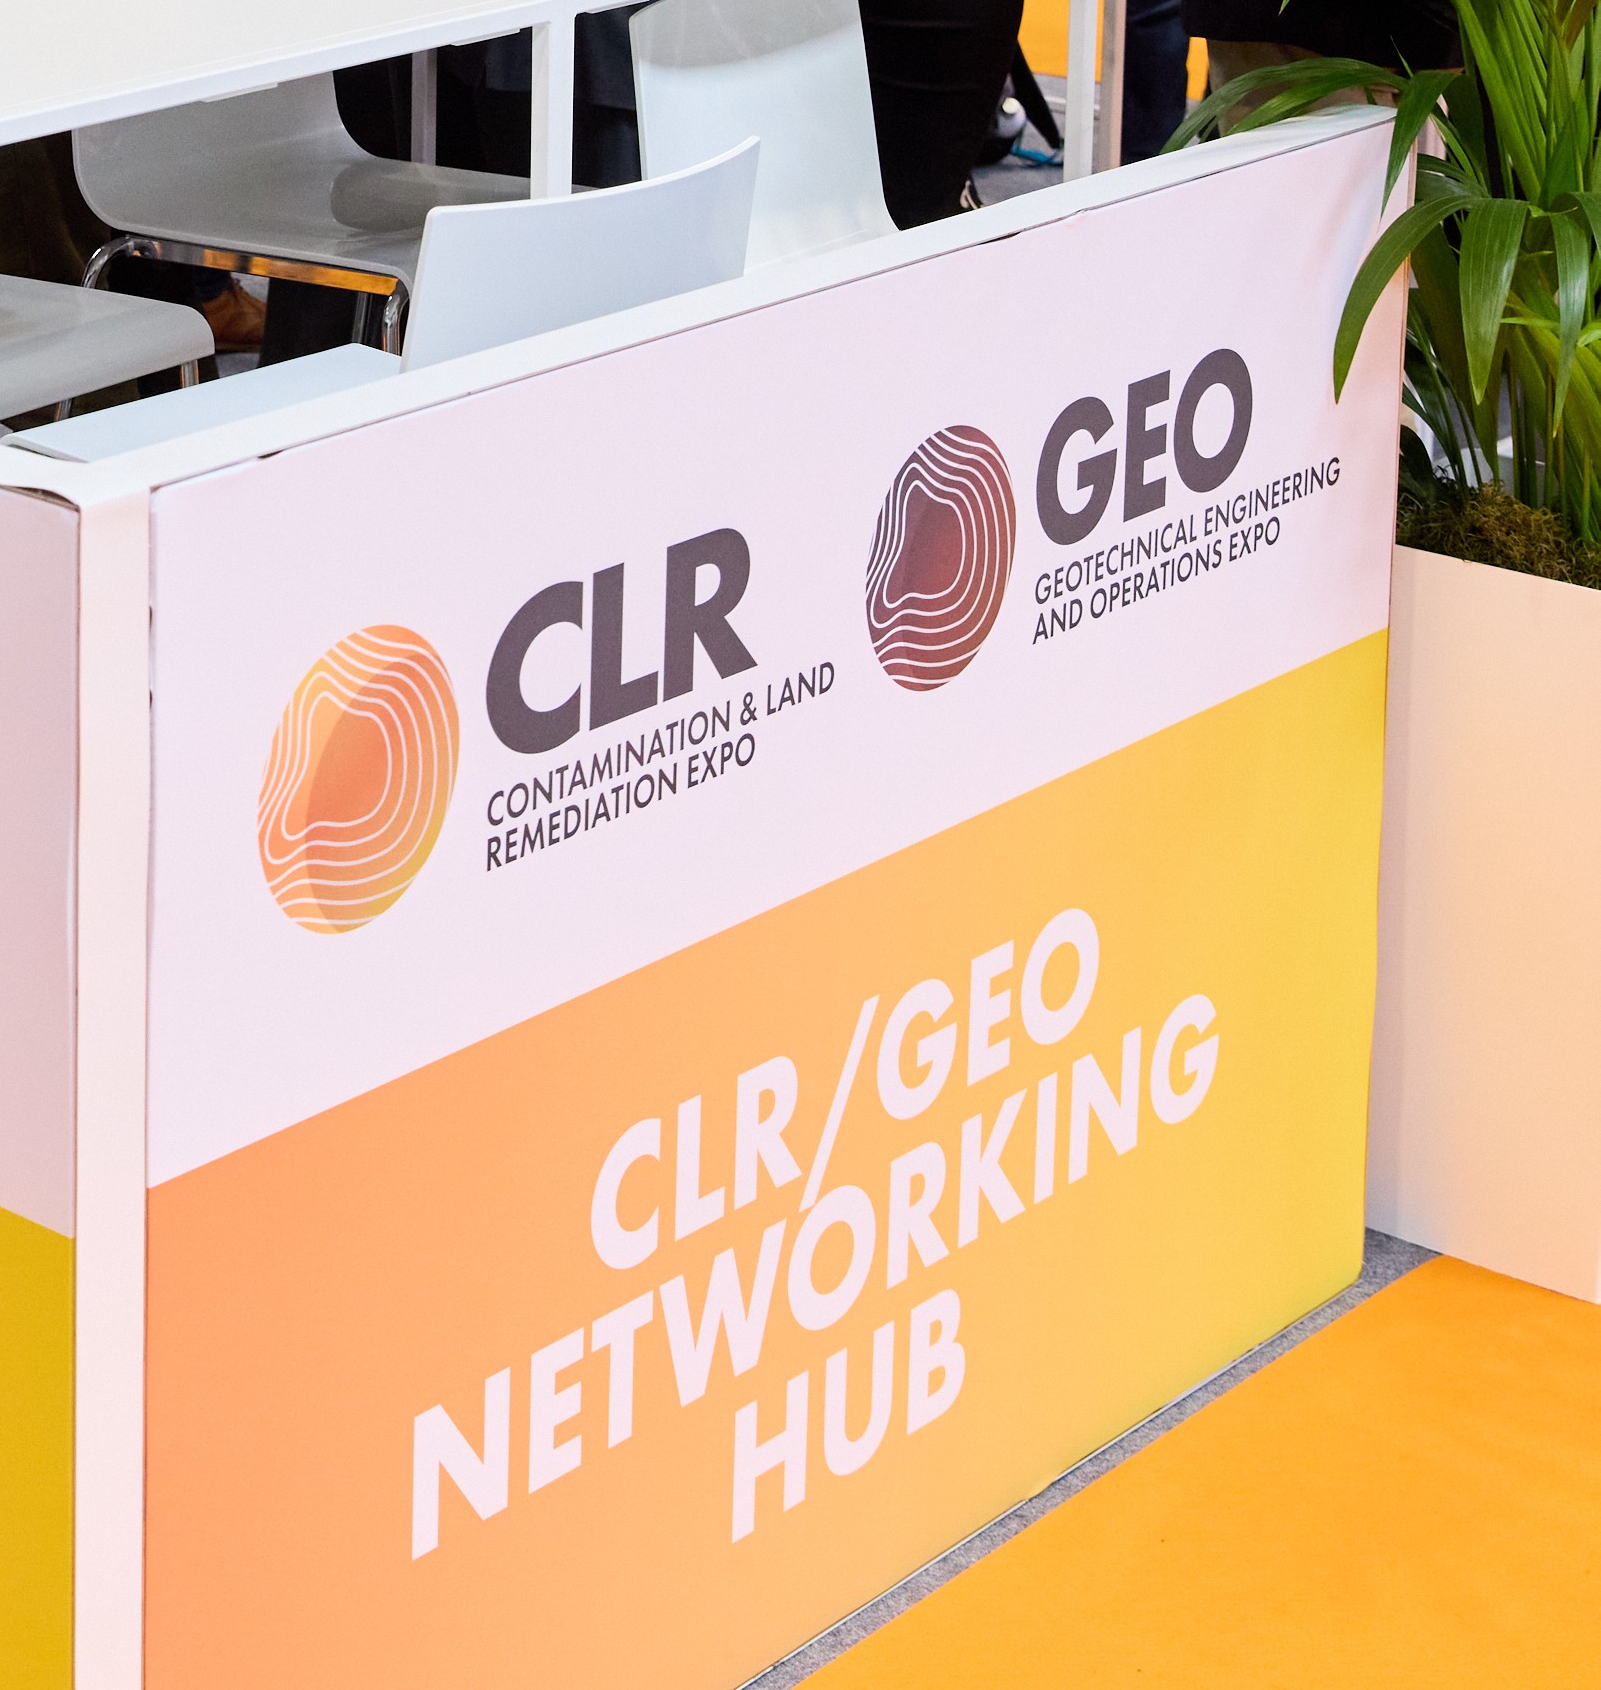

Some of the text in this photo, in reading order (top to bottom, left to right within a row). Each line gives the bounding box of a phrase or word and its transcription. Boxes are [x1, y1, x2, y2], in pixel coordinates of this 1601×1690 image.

[1035, 457, 1341, 605] GEOTECHNICAL ENGINEERING
[1036, 348, 1253, 546] GEO
[486, 527, 759, 755] CLR
[1032, 516, 1281, 646] AND OPERATIONS EXPO
[486, 661, 835, 827] CONTAMINATION & LAND
[486, 733, 756, 872] REMEDIATION EXPO
[590, 907, 1100, 1270] CLR/GEO
[411, 993, 1220, 1562] NETWORKING
[731, 1289, 966, 1545] HUB
